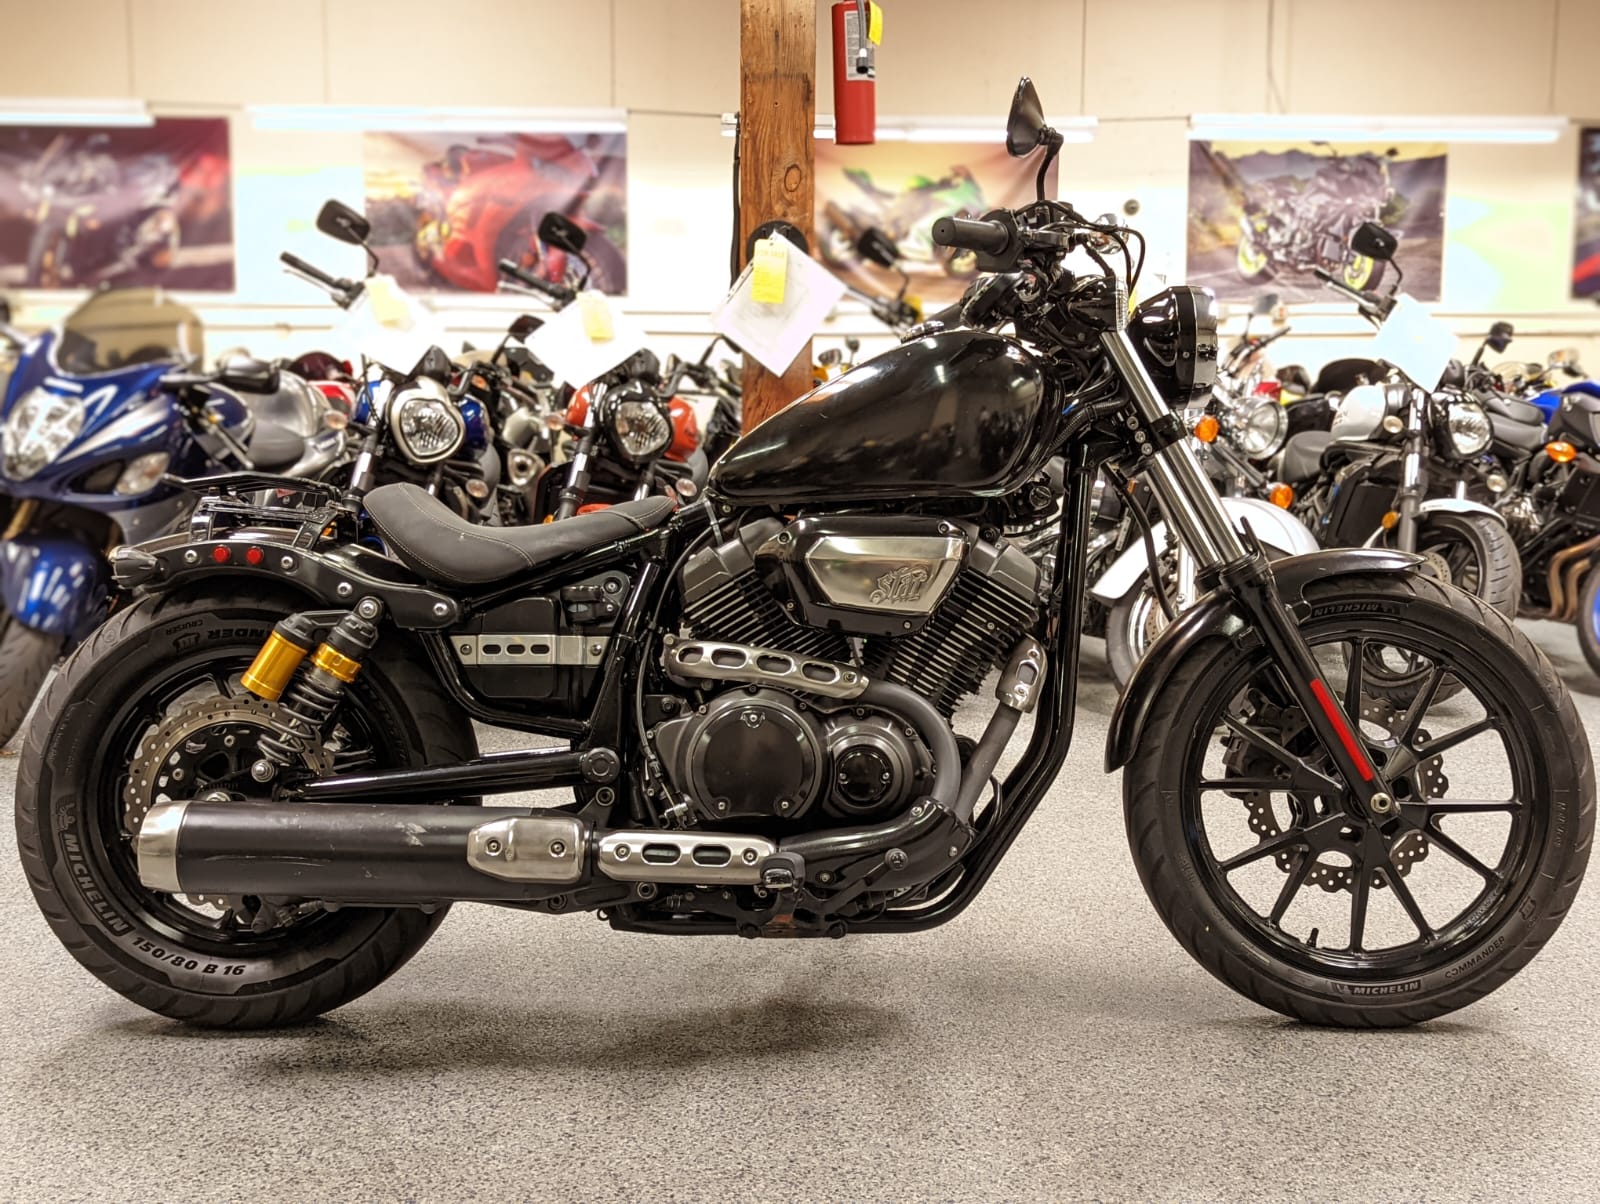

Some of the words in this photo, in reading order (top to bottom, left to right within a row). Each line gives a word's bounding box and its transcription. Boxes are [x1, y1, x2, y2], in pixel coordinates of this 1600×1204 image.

[63, 833, 130, 933] MICHELIN
[132, 936, 199, 971] 150/80
[202, 962, 220, 975] B
[223, 964, 247, 976] 16
[1444, 935, 1505, 979] COMMANDER
[1353, 981, 1420, 996] MICHELIN
